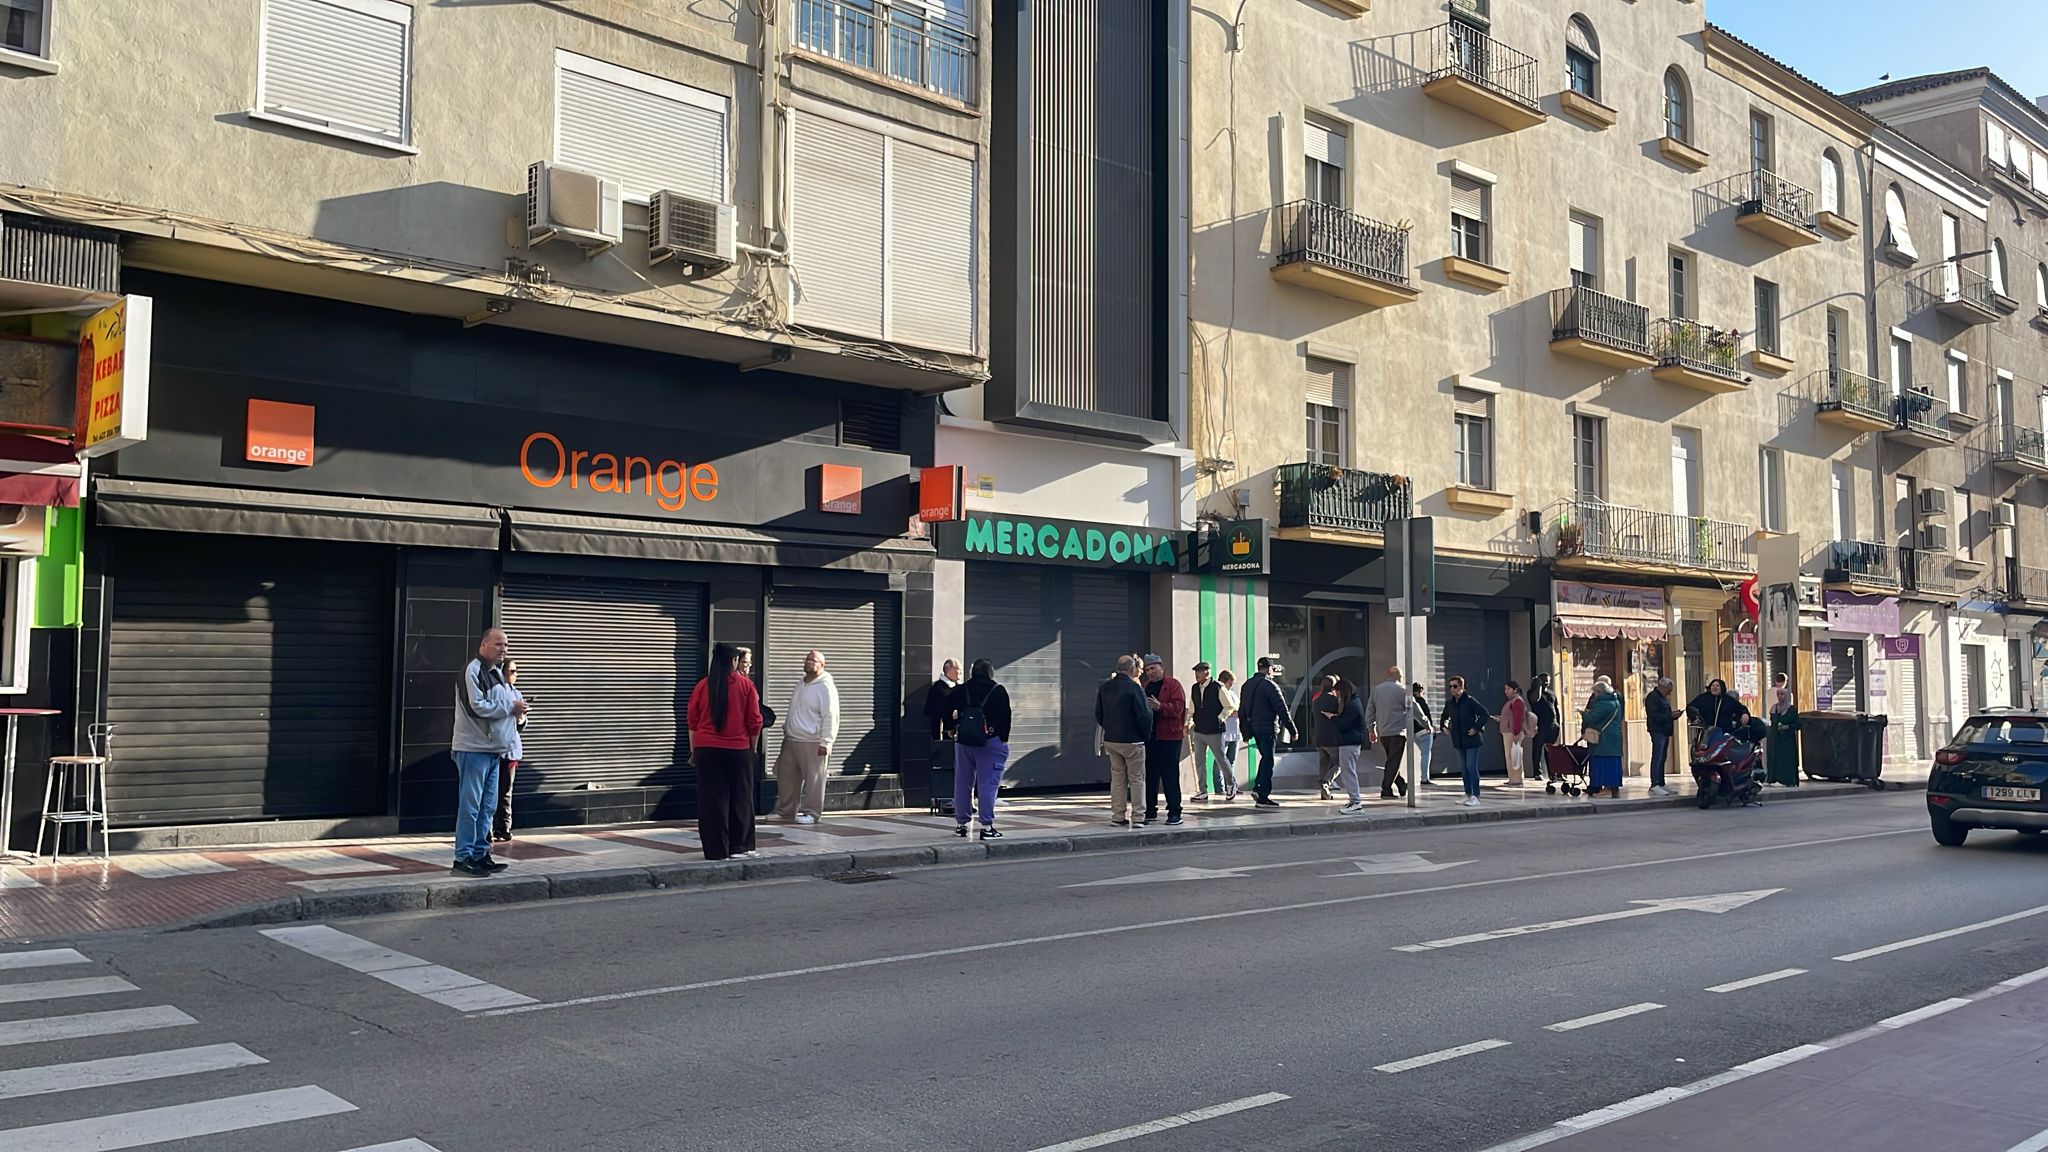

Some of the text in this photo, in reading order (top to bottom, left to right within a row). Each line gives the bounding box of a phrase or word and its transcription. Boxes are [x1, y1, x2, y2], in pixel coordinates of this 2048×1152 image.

[95, 350, 124, 382] KEBAB
[94, 392, 120, 421] PIZZA
[251, 445, 306, 462] orange
[520, 432, 718, 511] Orange
[824, 499, 857, 511] orange
[921, 505, 949, 519] orange
[965, 517, 1176, 566] MERCADONA
[1991, 787, 2014, 797] 1299
